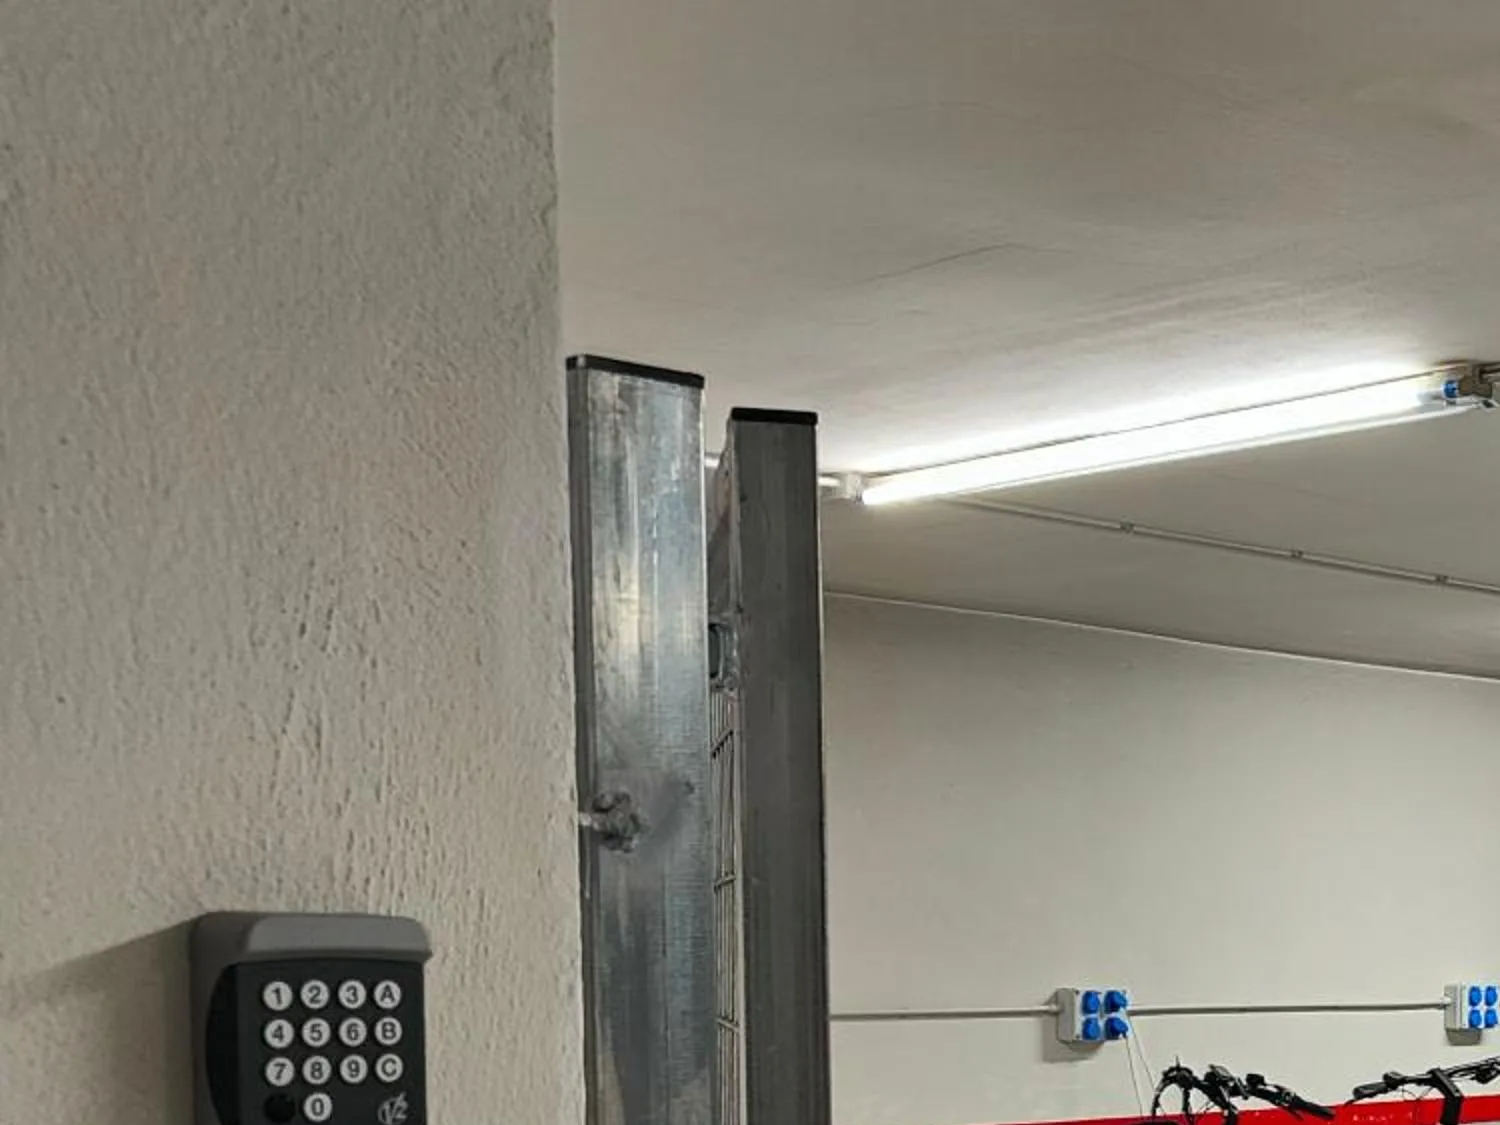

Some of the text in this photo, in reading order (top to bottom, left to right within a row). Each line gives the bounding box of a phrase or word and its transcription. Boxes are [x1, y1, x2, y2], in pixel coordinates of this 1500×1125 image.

[271, 984, 396, 1006] 1 2 3 A
[271, 1021, 397, 1043] 4 5 6 B
[273, 1057, 397, 1080] 7 8 9 C
[311, 1098, 325, 1117] 0
